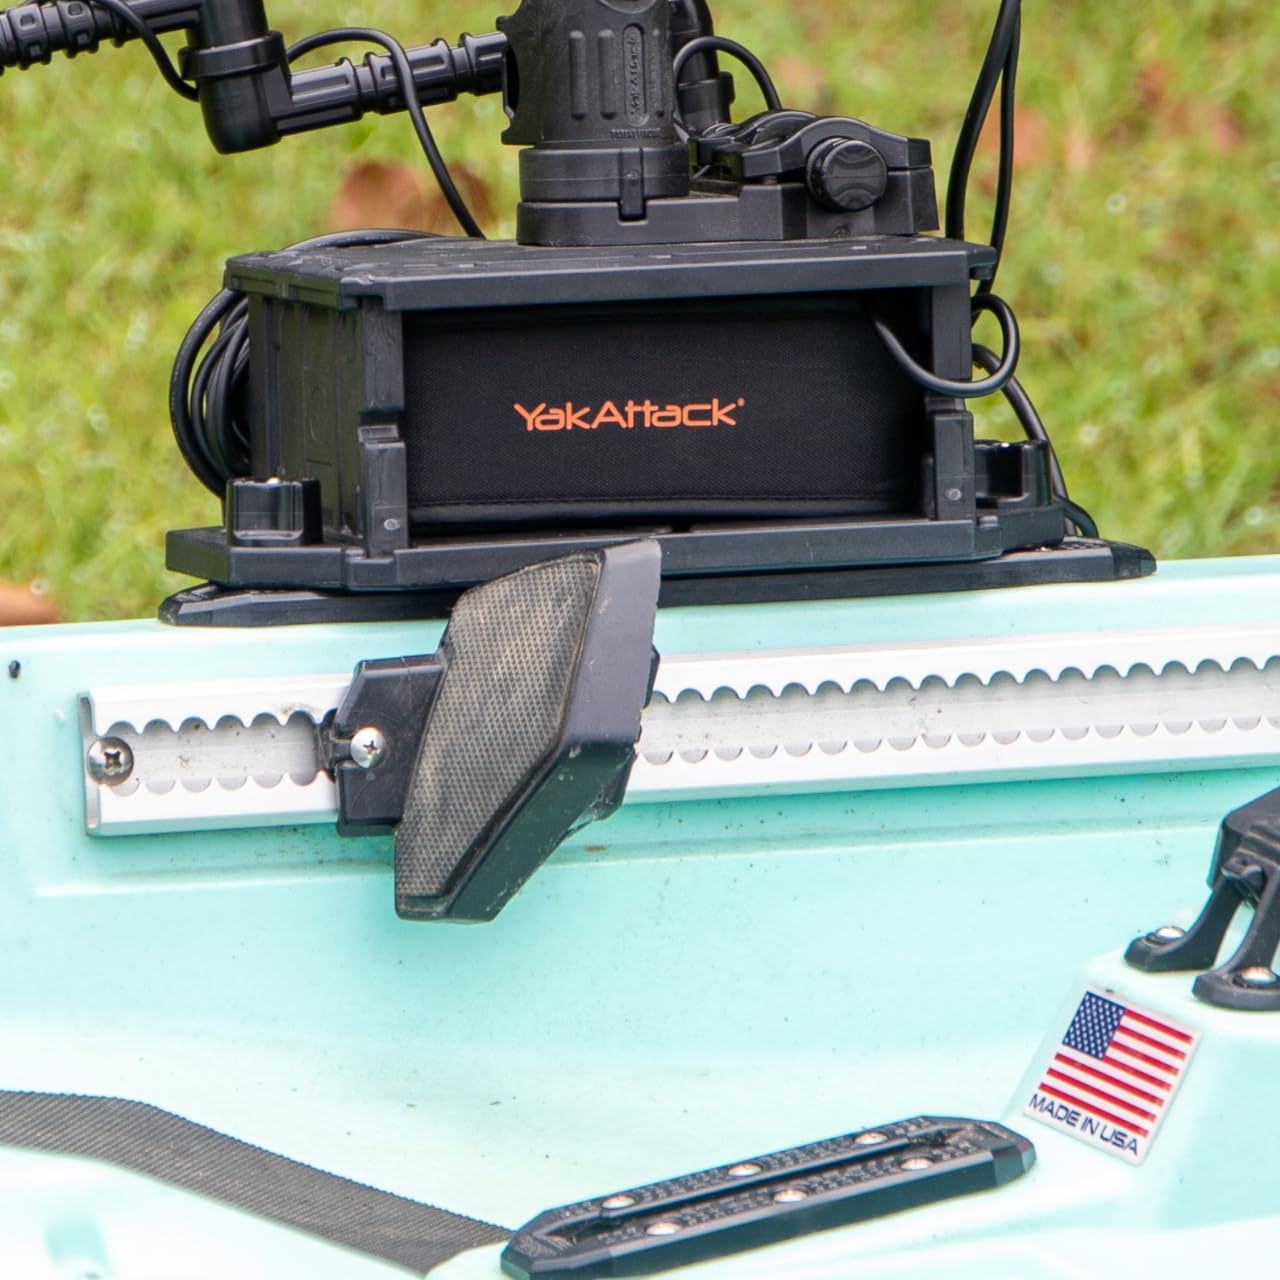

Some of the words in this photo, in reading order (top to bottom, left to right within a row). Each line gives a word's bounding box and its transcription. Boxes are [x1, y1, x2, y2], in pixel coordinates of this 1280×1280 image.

[513, 397, 738, 431] YakAttack
[1029, 1093, 1081, 1127] MADE
[1080, 1116, 1101, 1136] IN
[1099, 1123, 1139, 1156] USA
